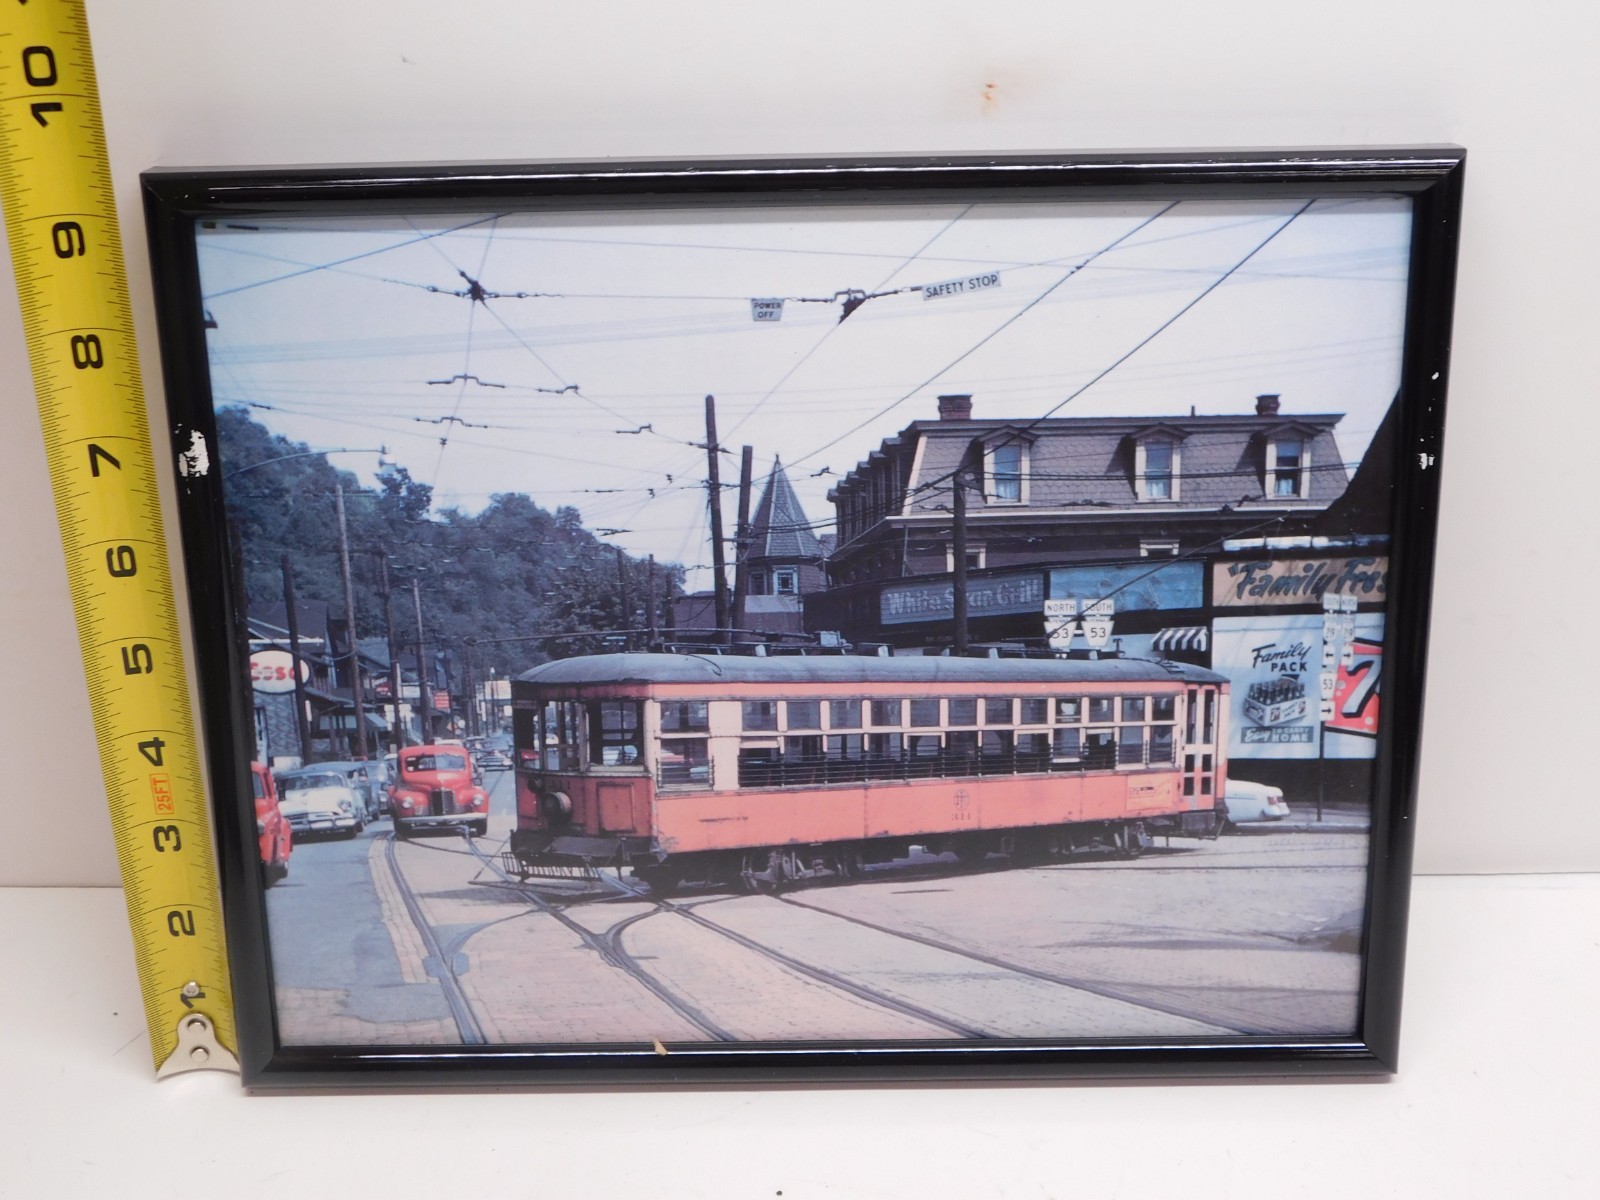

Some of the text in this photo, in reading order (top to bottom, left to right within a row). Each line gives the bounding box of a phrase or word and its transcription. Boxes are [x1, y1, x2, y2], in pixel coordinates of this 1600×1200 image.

[22, 45, 63, 128] 10
[52, 221, 86, 259] 9
[926, 274, 998, 298] SAFETY STOP
[754, 302, 782, 310] POWER
[757, 311, 774, 319] OFF
[70, 334, 103, 370] 8
[87, 443, 121, 478] 7
[106, 545, 137, 578] 6
[944, 587, 994, 609] San
[1047, 603, 1075, 612] NORTH
[1084, 603, 1112, 612] SOUTH
[1090, 627, 1106, 638] 53
[121, 643, 153, 676] 5
[1252, 642, 1312, 669] Family
[1271, 662, 1308, 672] PACK
[1322, 678, 1334, 690] 53
[1272, 734, 1309, 742] HOME
[138, 736, 166, 767] 4
[153, 777, 173, 811] 25FT
[153, 824, 182, 853] 3
[168, 910, 195, 937] 2
[180, 986, 206, 1010] 1
